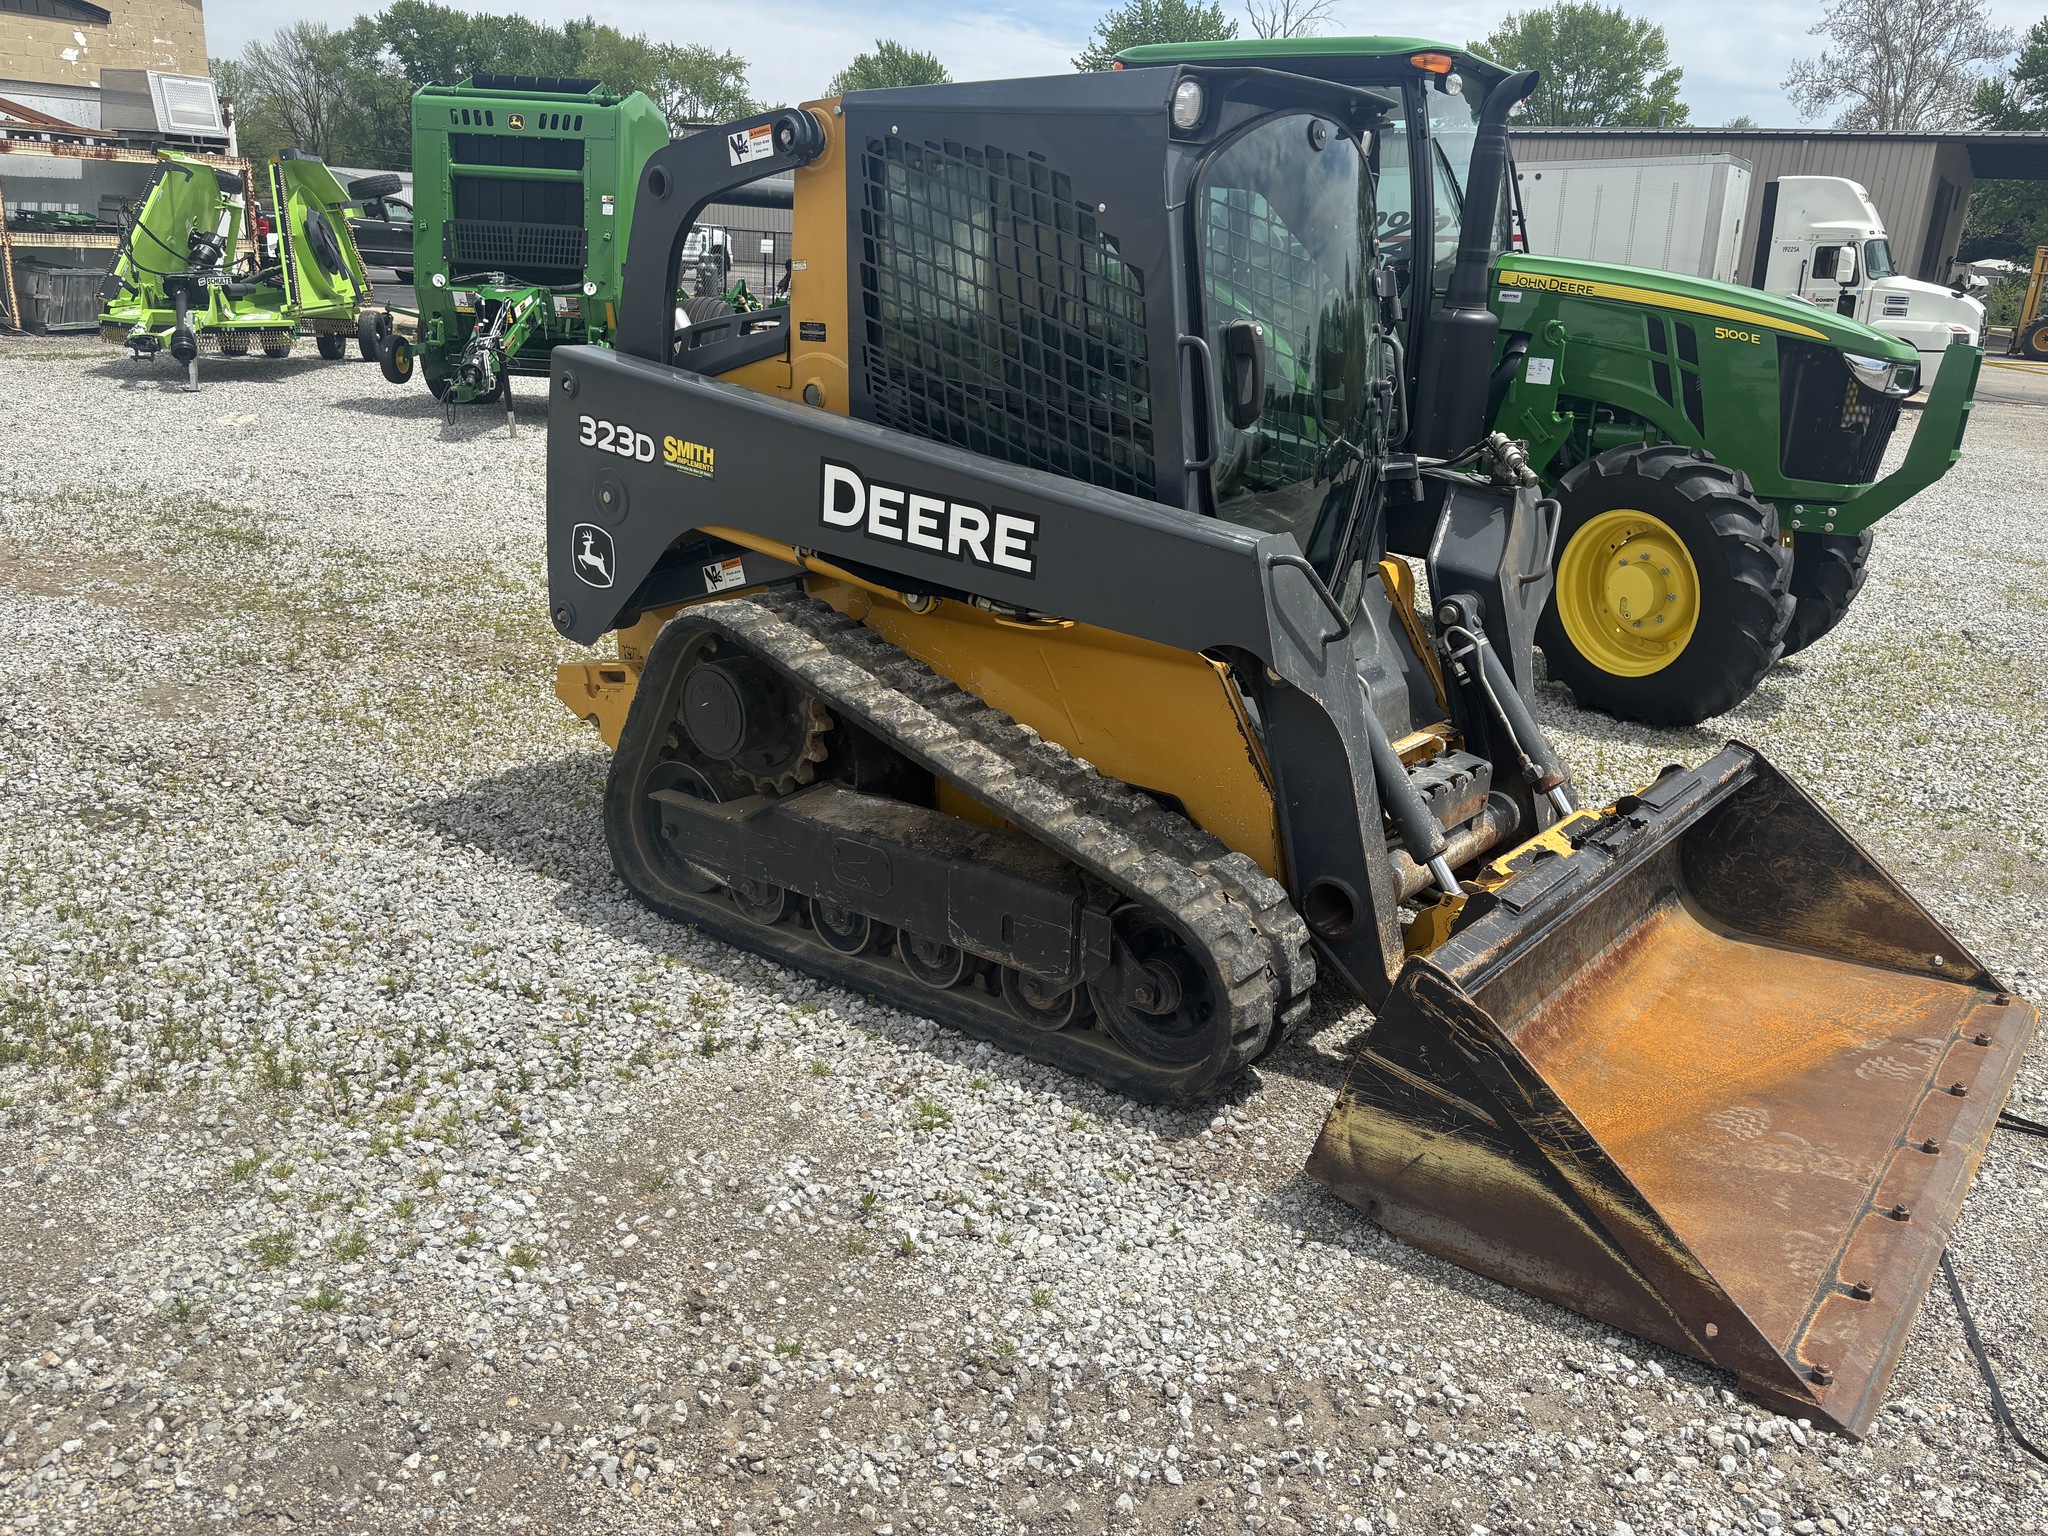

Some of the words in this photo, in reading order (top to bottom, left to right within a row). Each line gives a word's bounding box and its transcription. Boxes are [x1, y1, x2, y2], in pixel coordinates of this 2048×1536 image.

[207, 277, 231, 285] SCHULTE
[1511, 274, 1547, 289] JOHN
[1549, 278, 1595, 295] DEERE
[1714, 326, 1749, 342] 5100
[1751, 333, 1761, 345] E
[579, 415, 656, 462] 323D
[663, 435, 715, 466] SMITH
[676, 456, 715, 473] IMPLEMENTS
[823, 463, 1036, 573] DEERE
